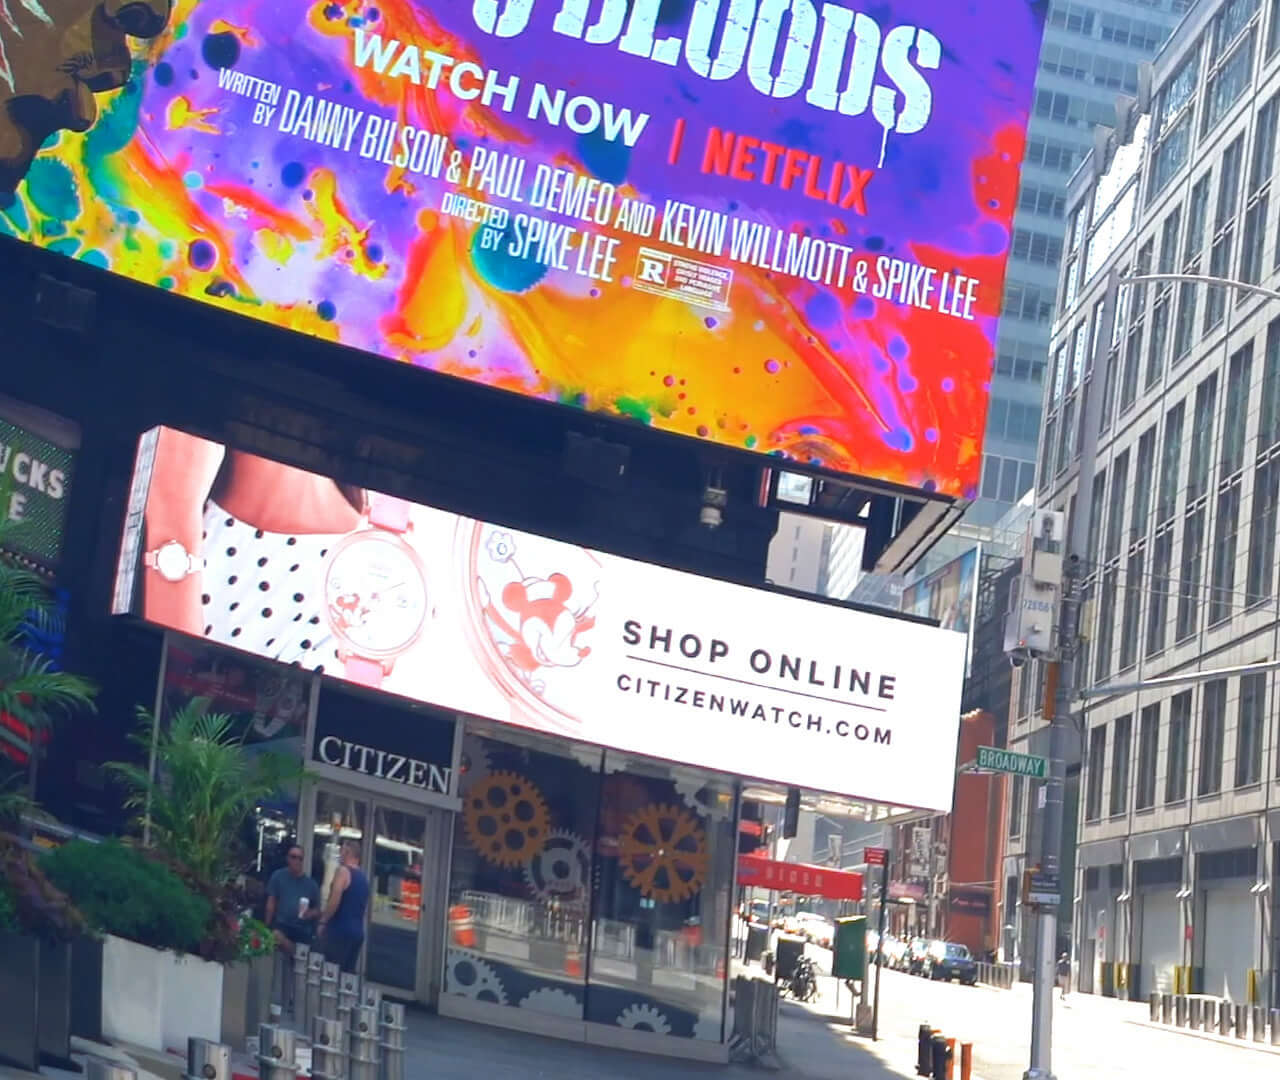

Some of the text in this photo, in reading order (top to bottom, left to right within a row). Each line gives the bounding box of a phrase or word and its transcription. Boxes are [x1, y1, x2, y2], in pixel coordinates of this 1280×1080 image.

[253, 103, 276, 127] BY
[350, 27, 874, 216] WATCH NOW NETFLIX
[218, 67, 980, 321] WRITTEN DANNY BILSON & PAUL DEMEO AND KEVIN WILLMOTT & SPIKE LEE
[440, 192, 621, 283] DIRECTED SPIKE LEE
[480, 228, 504, 252] BY
[638, 257, 665, 285] R
[622, 619, 898, 701] SHOP ONLINE
[616, 674, 893, 746] CITIZENWATCH.COM
[318, 734, 453, 796] CITIZEN
[979, 749, 1042, 775] BROADWAY
